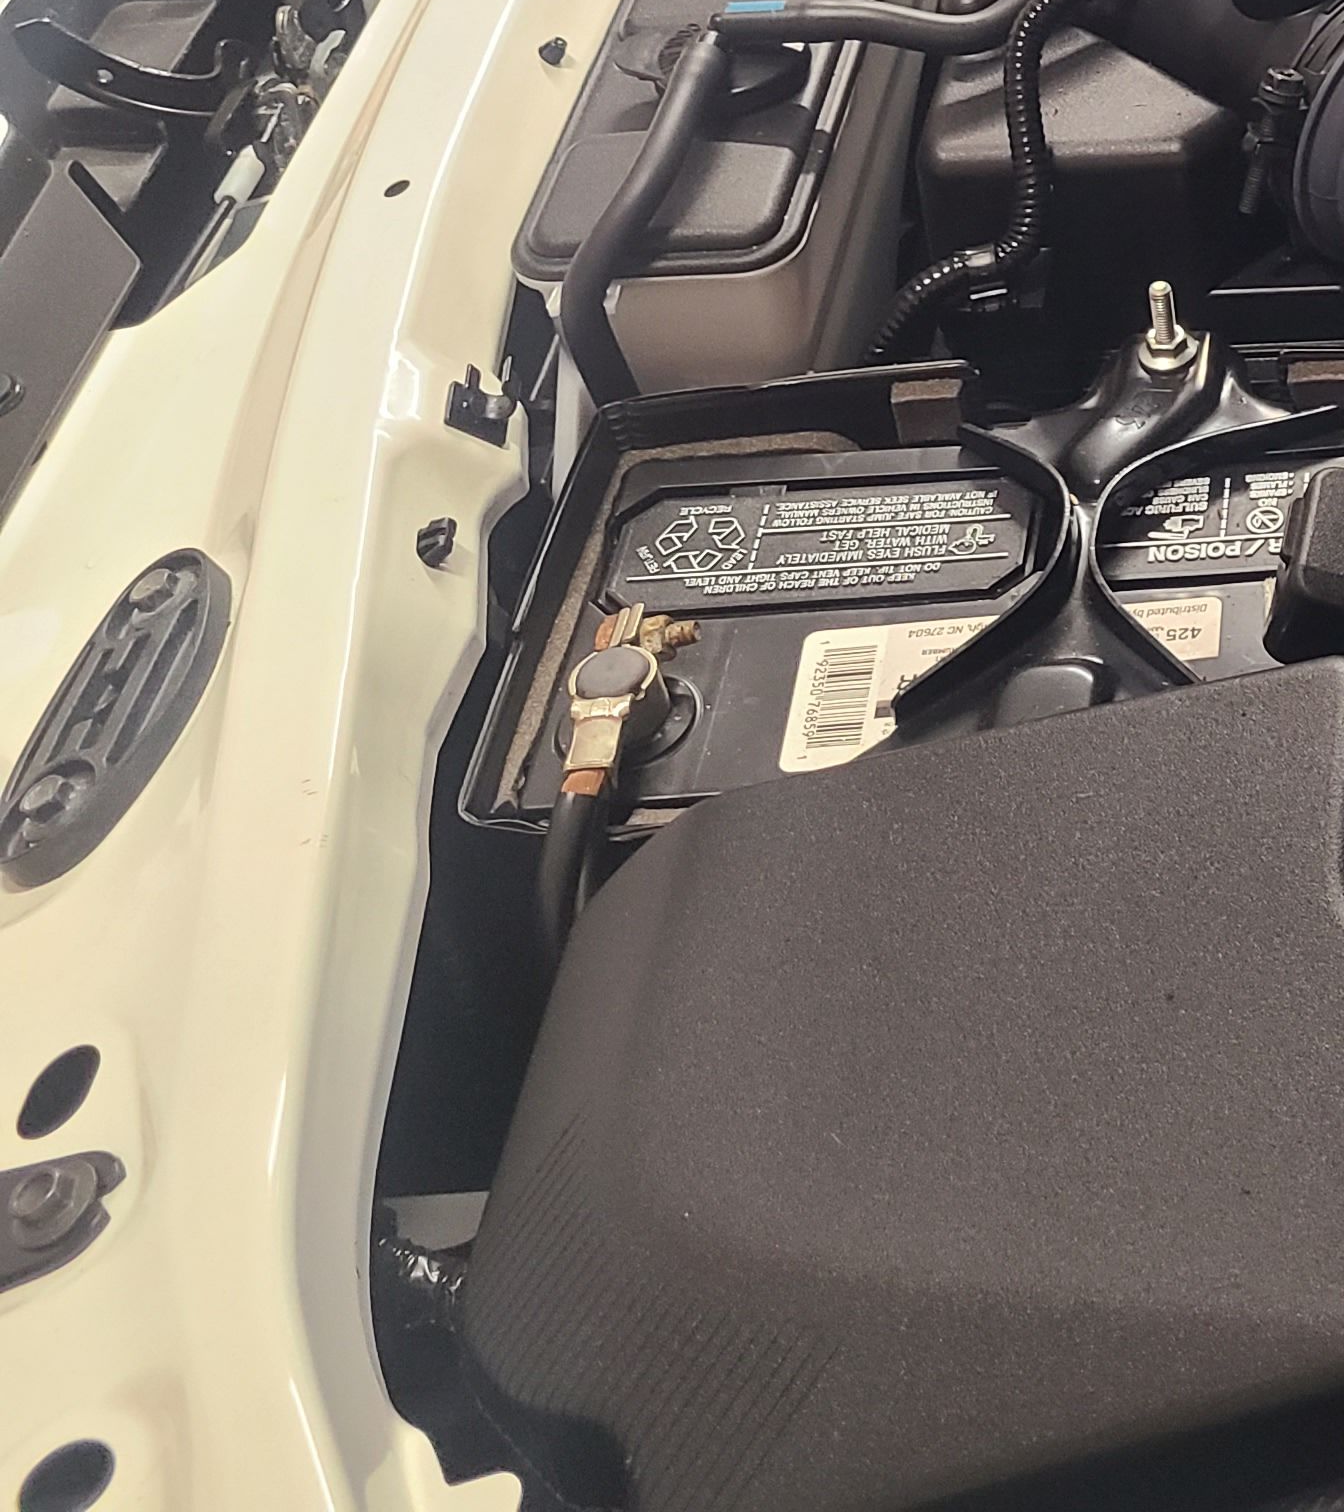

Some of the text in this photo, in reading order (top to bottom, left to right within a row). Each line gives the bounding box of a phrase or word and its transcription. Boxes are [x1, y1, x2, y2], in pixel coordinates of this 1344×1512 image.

[911, 492, 962, 502] AVAILABLE
[965, 491, 985, 499] NOT
[840, 497, 882, 507] SERVICE
[923, 498, 993, 509] INSTRUCTIONS
[679, 504, 732, 516] RECYCLE
[866, 504, 907, 513] VEHICLE
[1145, 502, 1208, 514] SULFURIC
[816, 514, 864, 524] STARTING
[866, 513, 894, 521] JUMP
[897, 511, 923, 520] SAFE
[772, 518, 813, 527] FOLLOW
[819, 524, 950, 540] MEDICAL HELP FAST
[832, 540, 860, 550] GET
[912, 535, 948, 545] WITH
[721, 549, 748, 570] LEAD
[776, 545, 947, 565] FLUSH EYES IMMEDIATELY
[841, 567, 871, 576] KEEP
[896, 564, 922, 572] NOT
[925, 563, 941, 571] DO
[745, 573, 776, 583] TIGHT
[780, 571, 809, 580] CAPS
[811, 569, 840, 578] VENT
[683, 577, 716, 586] LEVEL
[703, 572, 915, 594] KEEP OUT OF THE REACH OF CHILDREN
[718, 575, 742, 584] AND
[1146, 603, 1208, 618] Distributed
[907, 627, 945, 638] 27604
[946, 625, 964, 635] NC
[1165, 627, 1202, 641] 425
[811, 659, 829, 696] 92350
[802, 701, 821, 737] 76859
